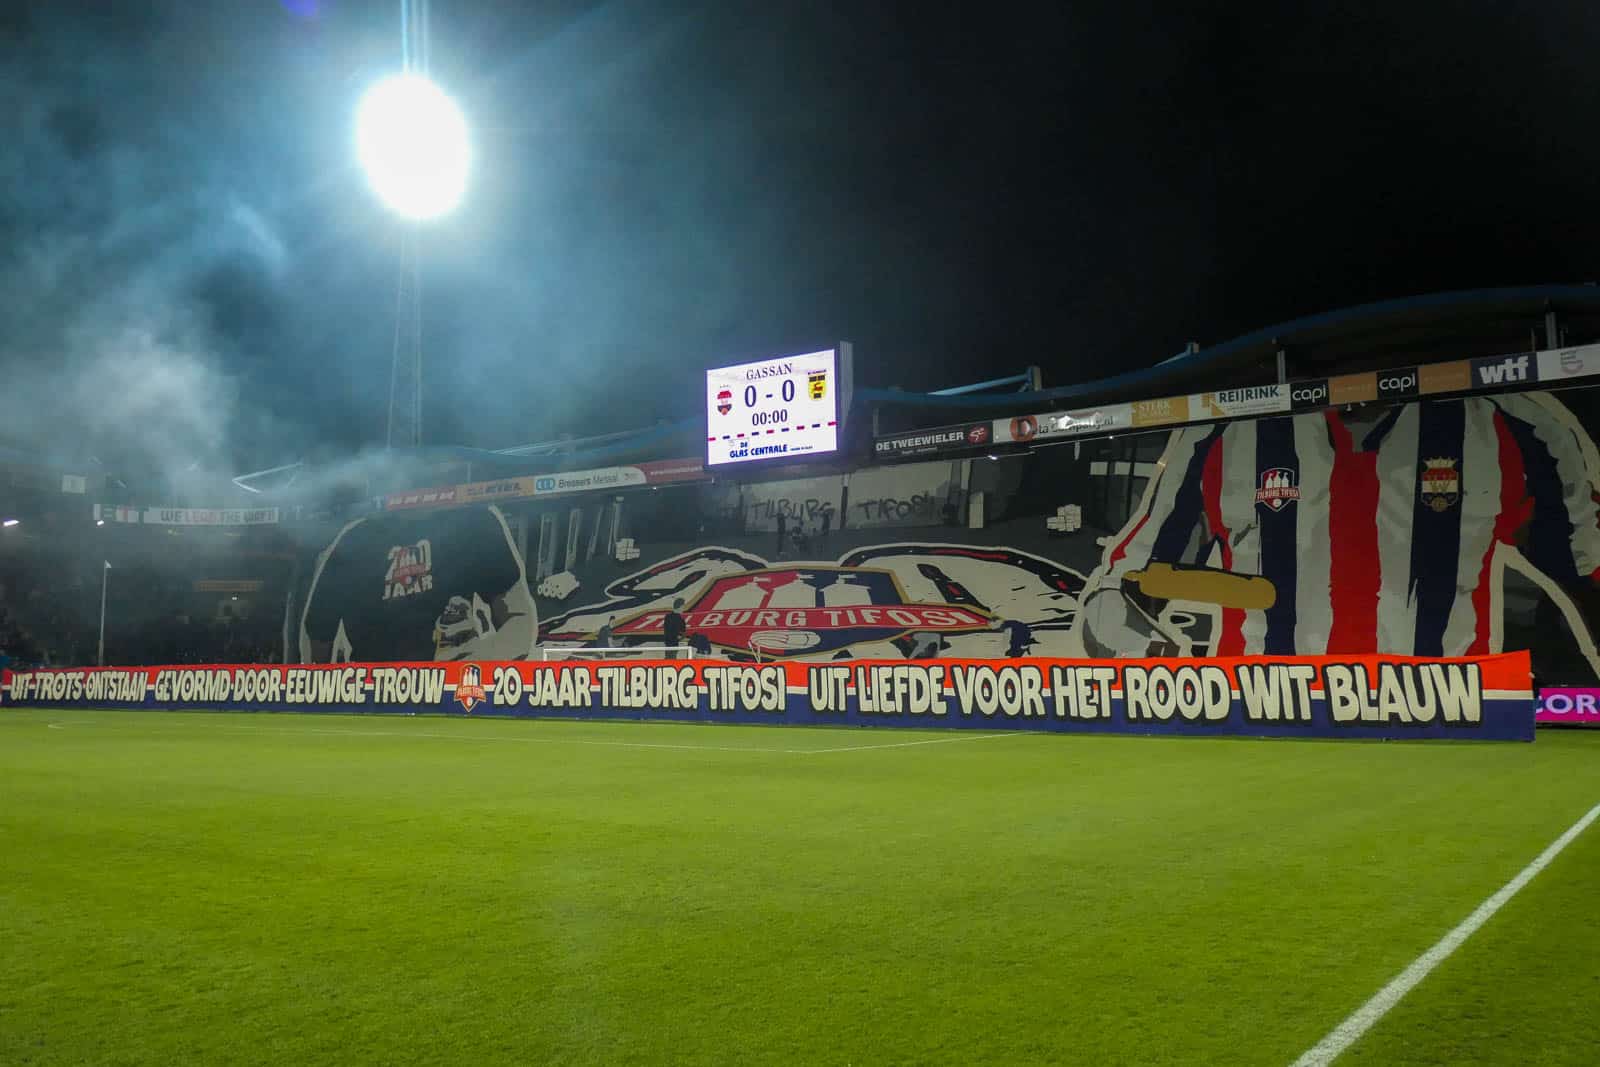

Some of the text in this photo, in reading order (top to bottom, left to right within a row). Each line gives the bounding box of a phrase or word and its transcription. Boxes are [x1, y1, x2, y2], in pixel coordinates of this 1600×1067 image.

[746, 363, 793, 380] GASSAN
[1479, 356, 1528, 384] wtf
[1379, 373, 1416, 392] capi
[744, 385, 757, 407] 0
[782, 379, 795, 402] 0
[1219, 386, 1280, 403] REIJRINK
[1292, 385, 1327, 403] capi
[752, 409, 788, 426] 00:00
[876, 441, 890, 451] DE
[892, 431, 965, 449] TWEEWIELER
[730, 444, 788, 458] GLAS CENTRALE
[822, 608, 979, 627] TIFOSI
[10, 668, 446, 703] UIT TROTS ONTSTAAN GEVORMD DOOR EEUWIGE TROUW
[494, 665, 1480, 721] 20 JAAR TILBURG TIFOSI UIT LIEFDE VOOR HET ROOD WIT BLAUW
